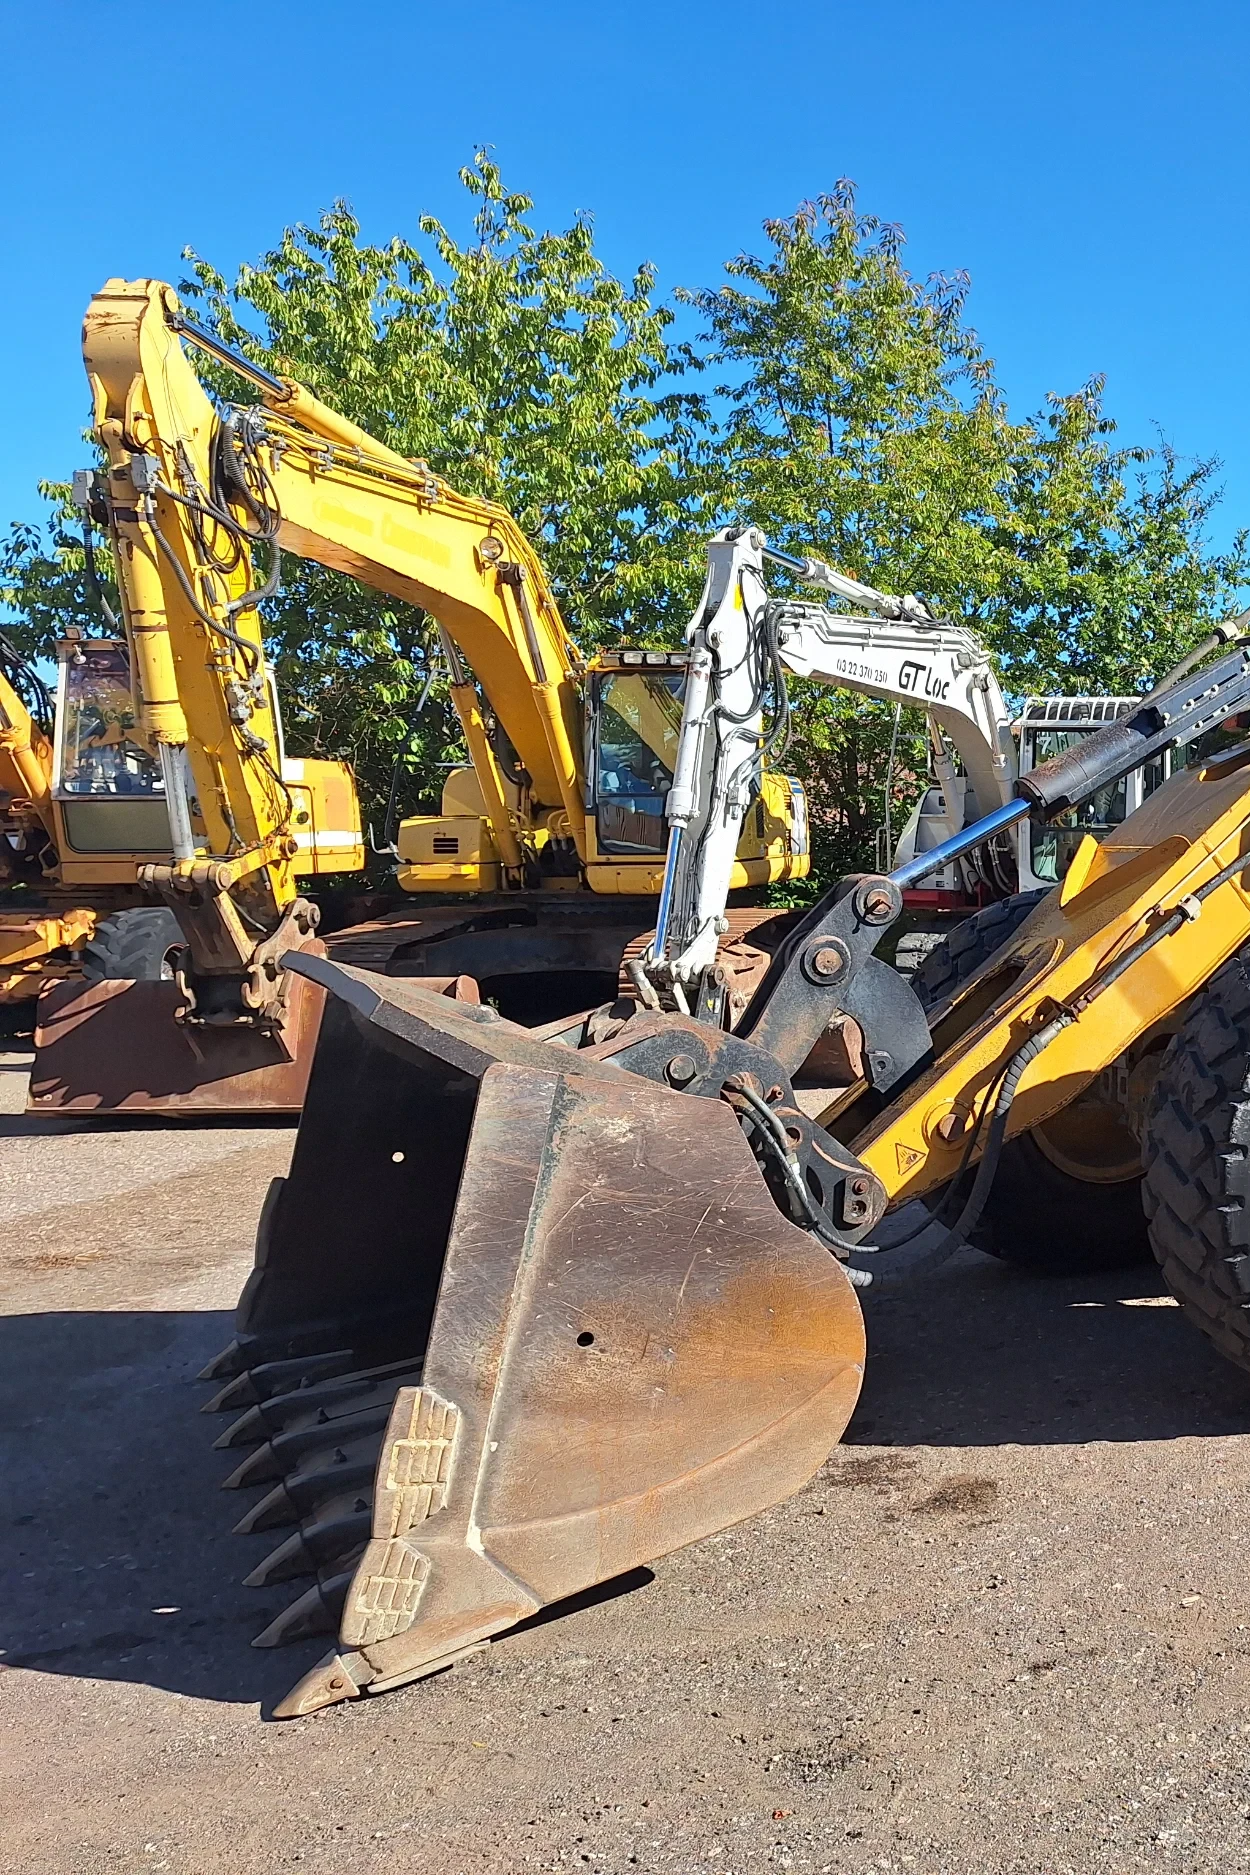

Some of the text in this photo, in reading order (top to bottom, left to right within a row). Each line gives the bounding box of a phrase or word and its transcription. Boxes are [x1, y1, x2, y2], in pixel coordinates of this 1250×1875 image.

[848, 661, 858, 676] 22
[858, 664, 873, 679] 370
[874, 669, 888, 683] 250
[898, 660, 951, 700] GT Loc
